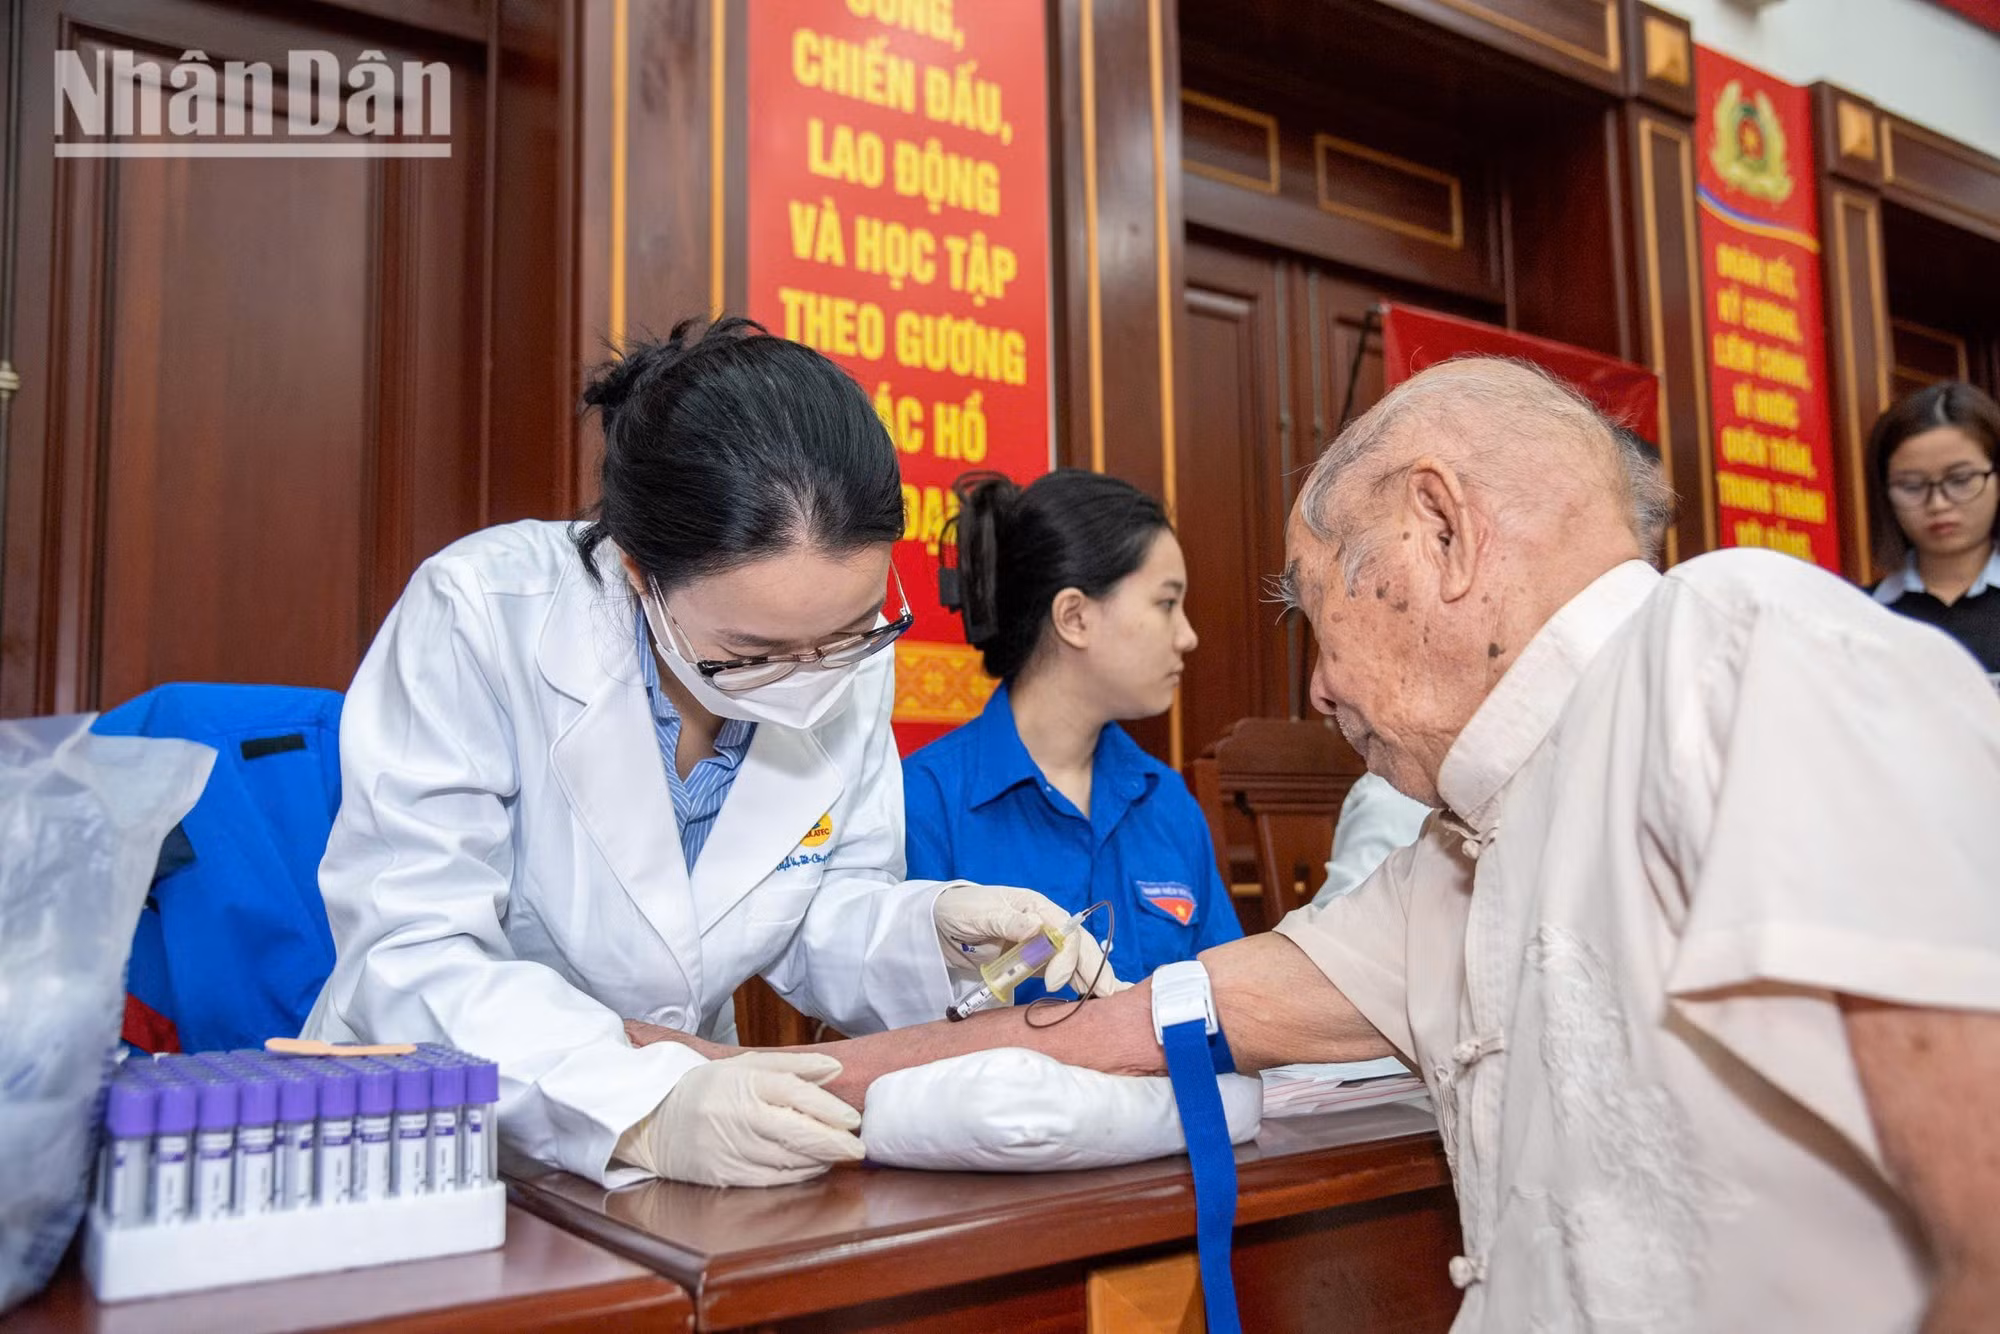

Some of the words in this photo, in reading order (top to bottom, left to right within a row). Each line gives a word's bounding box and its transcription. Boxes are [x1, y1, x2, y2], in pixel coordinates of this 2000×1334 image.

[792, 28, 916, 114] CHIẾN
[924, 60, 1013, 146] ĐẤU,
[808, 117, 885, 189] LAO
[893, 137, 1001, 217] ĐỘNG
[788, 195, 846, 267] VÀ
[855, 214, 937, 290] HỌC
[944, 230, 1018, 307] TẬP
[779, 288, 885, 361] THEO
[895, 310, 1027, 385] GƯƠNG
[874, 381, 925, 454] ÁC
